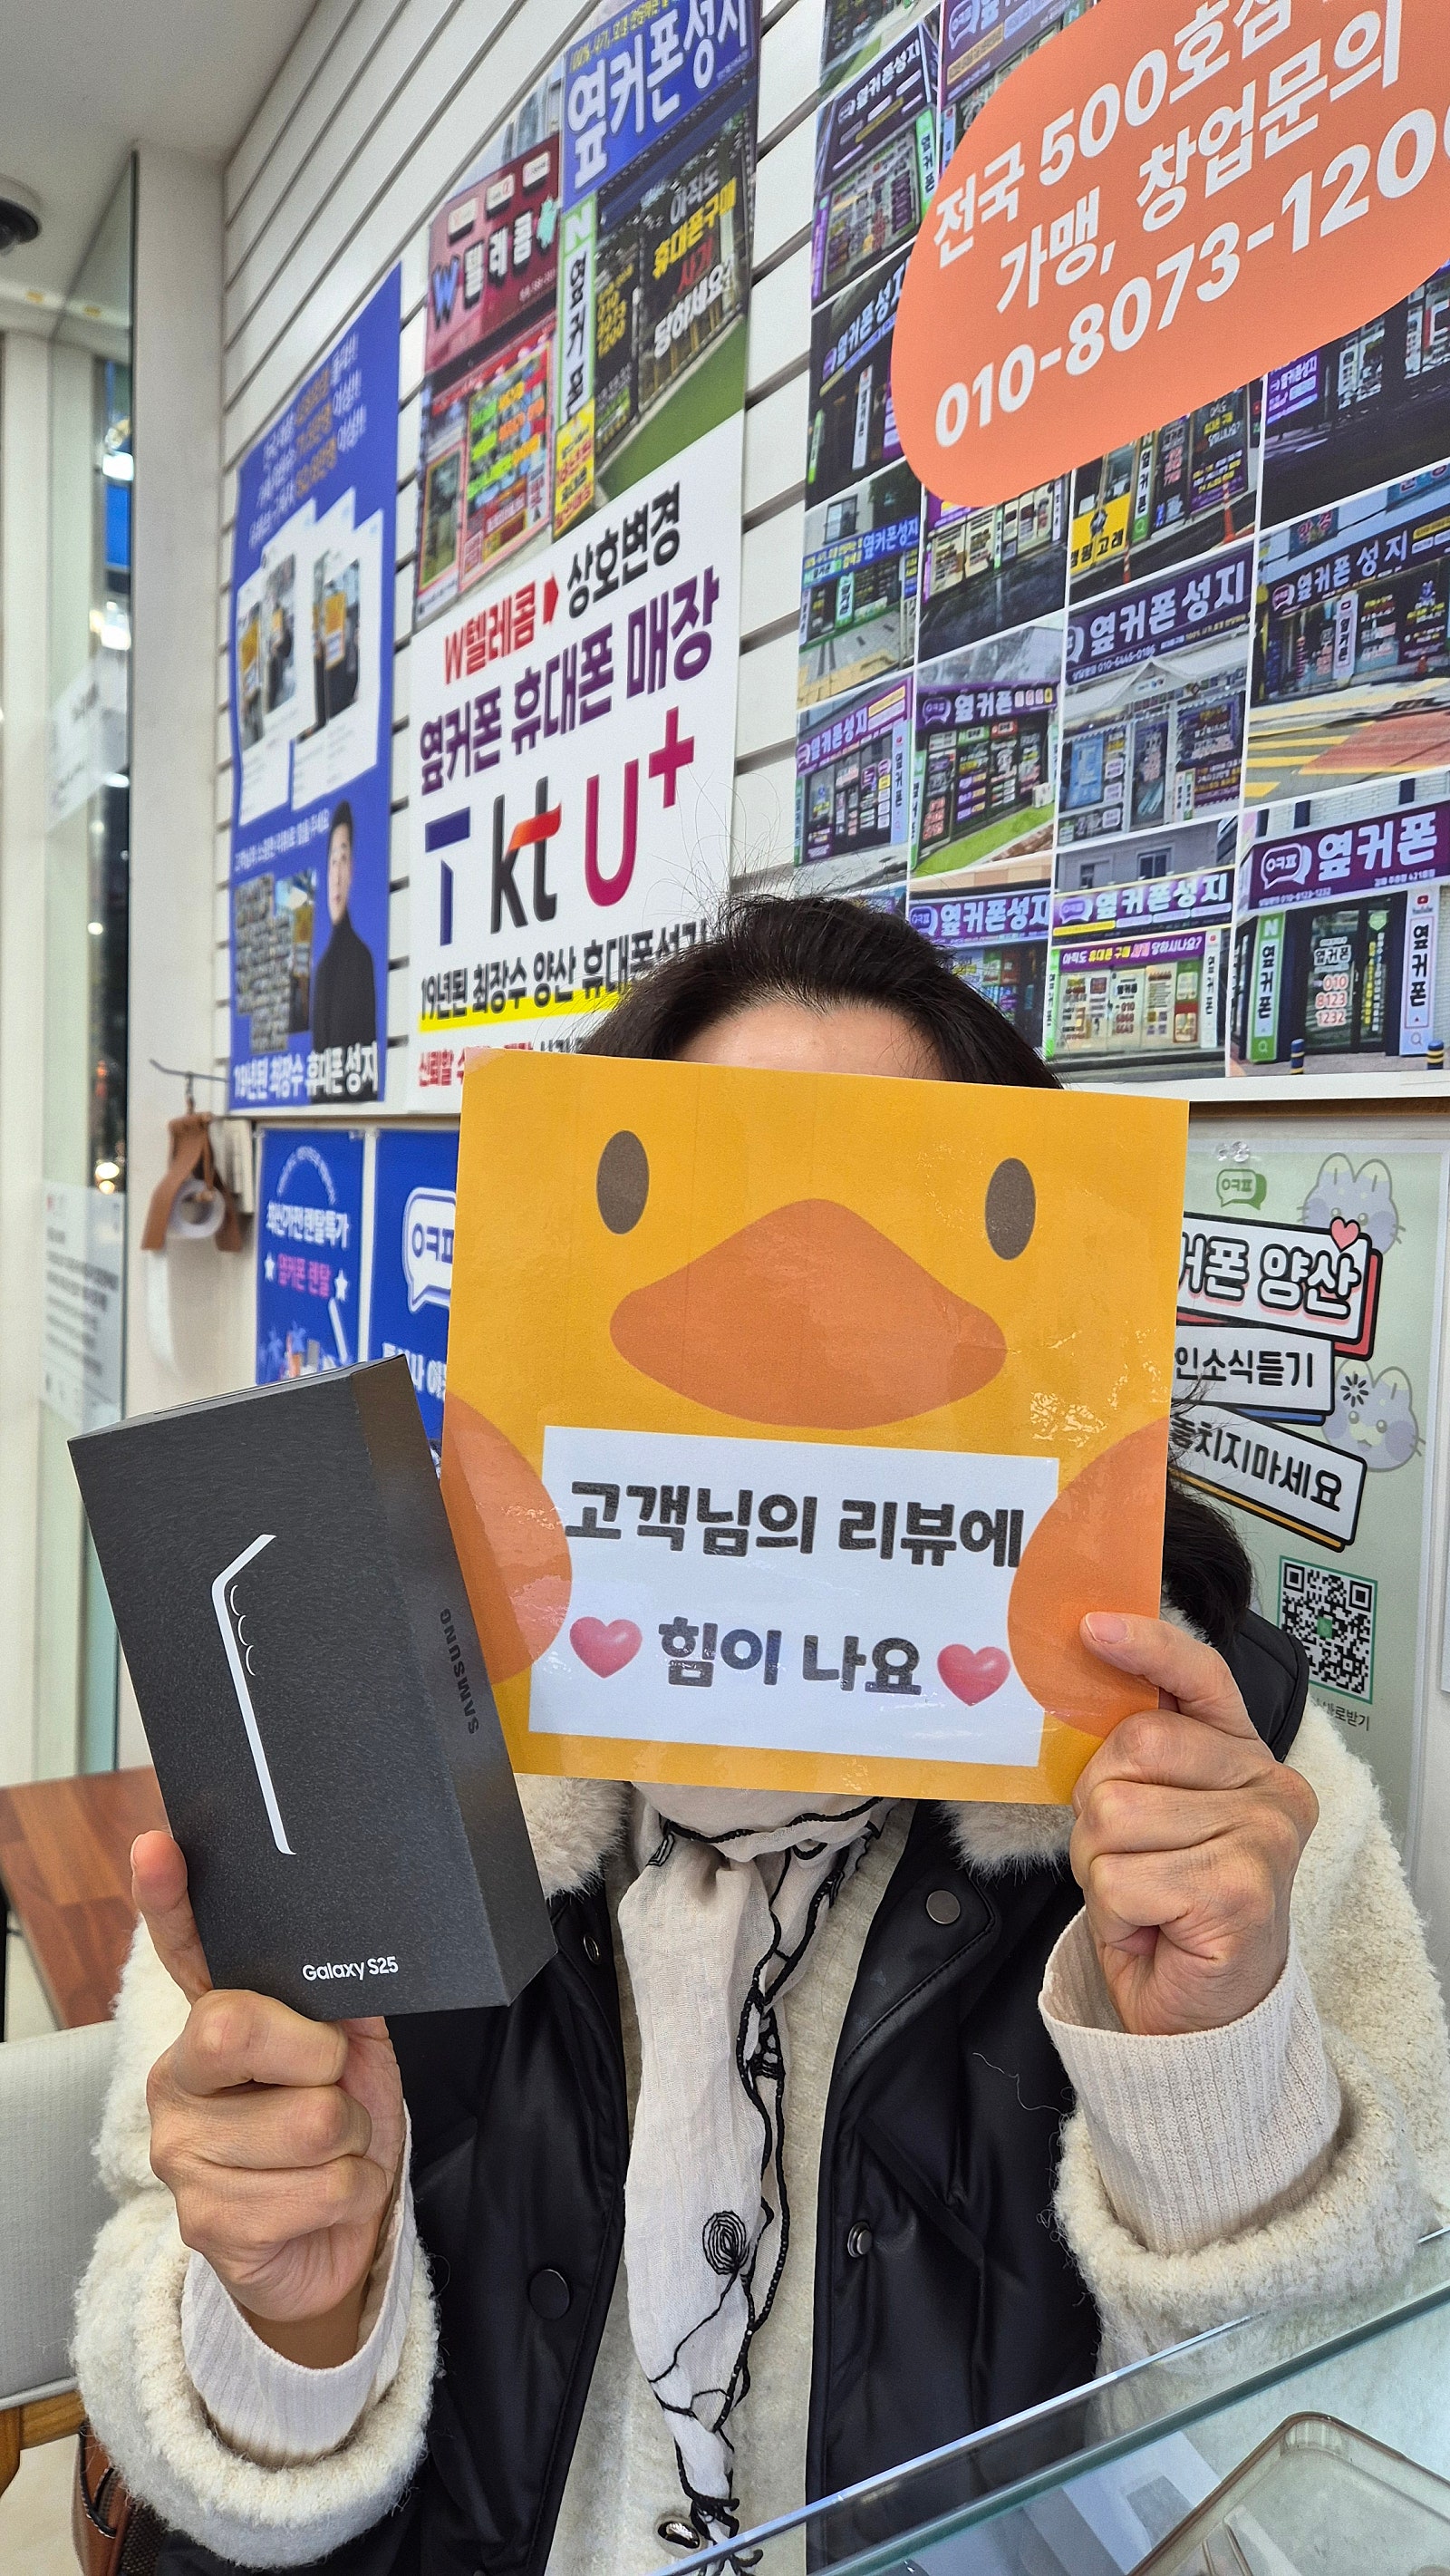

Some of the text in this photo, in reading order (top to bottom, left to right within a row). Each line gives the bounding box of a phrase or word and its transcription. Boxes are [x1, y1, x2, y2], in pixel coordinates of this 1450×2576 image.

[934, 0, 1291, 268] 전국 500호점
[996, 0, 1402, 314] 가맹, 창업문의
[670, 161, 719, 225] 아직도
[678, 237, 713, 295] 사기
[935, 104, 1450, 448] 010-8073-120
[863, 516, 919, 560] 옆커폰성지
[1297, 529, 1407, 603] 옆커폰성지
[443, 581, 536, 685] W텔레콤
[566, 481, 680, 618] 상호변경
[1090, 560, 1245, 656] 옆커폰성지
[420, 565, 720, 796] 옆커폰 휴대폰 매장
[954, 691, 1012, 723] 옆커폰
[424, 706, 695, 946] T kt U+
[1318, 811, 1437, 882] 옆커폰
[941, 894, 1050, 936] 옆커폰성지
[1096, 874, 1227, 920] 옆커폰성지
[1264, 920, 1279, 936] N
[421, 967, 468, 1021] 19년된
[473, 953, 527, 1014] 최장수
[534, 946, 576, 1008] 양산
[1258, 945, 1275, 1019] 옆커폰
[1317, 993, 1347, 1008] 8123
[1324, 974, 1348, 990] 010
[1411, 925, 1429, 1007] 옆커폰
[1318, 1011, 1346, 1024] 1232
[305, 1047, 344, 1097] 휴대폰
[345, 1041, 379, 1094] 성지
[1258, 1244, 1361, 1320] 양산
[1175, 1347, 1313, 1389] 인소식듣기
[565, 1481, 1024, 1568] 고객님의 리뷰에
[439, 1608, 479, 1735] SAMSUNG
[658, 1616, 923, 1696] 힘이 나요
[302, 1955, 399, 1980] Galaxy S25
